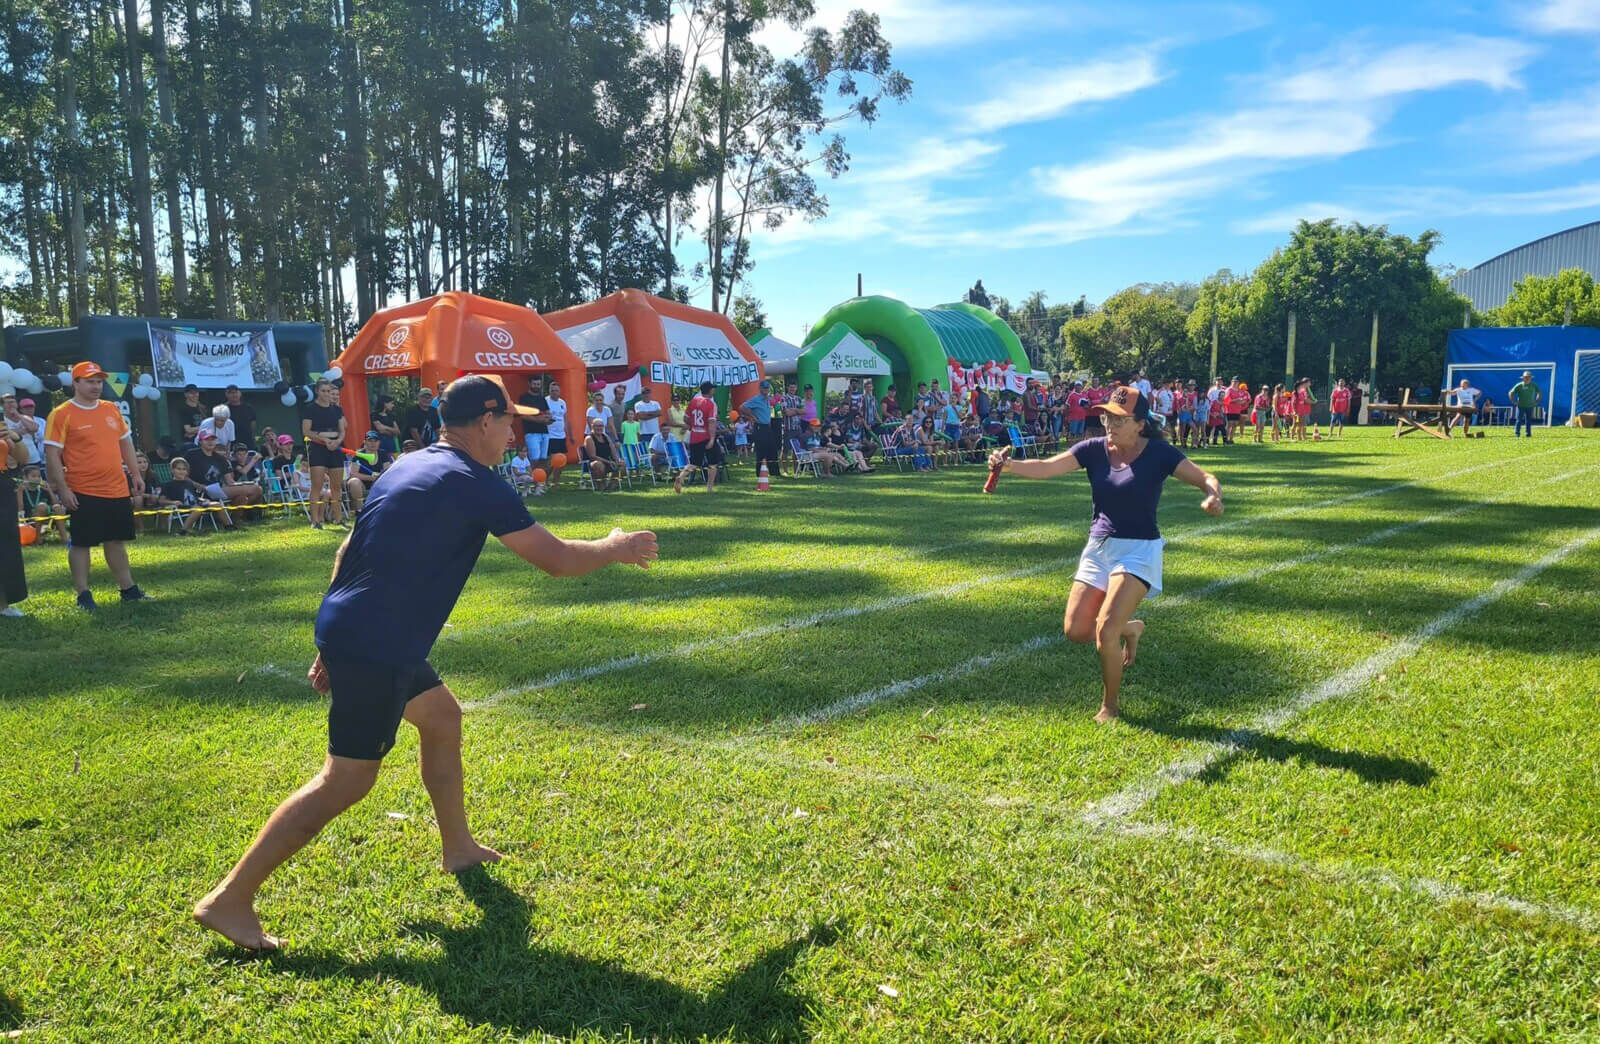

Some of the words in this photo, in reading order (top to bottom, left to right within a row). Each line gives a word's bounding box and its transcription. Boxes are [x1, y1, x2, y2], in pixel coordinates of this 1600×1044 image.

[186, 341, 209, 356] VILA
[211, 343, 245, 357] CARMO
[687, 347, 739, 361] CRESOL
[364, 352, 412, 370] CRESOL
[475, 352, 547, 367] CRESOL
[844, 354, 878, 369] Sicredi
[652, 362, 759, 386] ENCRUZILHADA
[691, 409, 705, 426] 18
